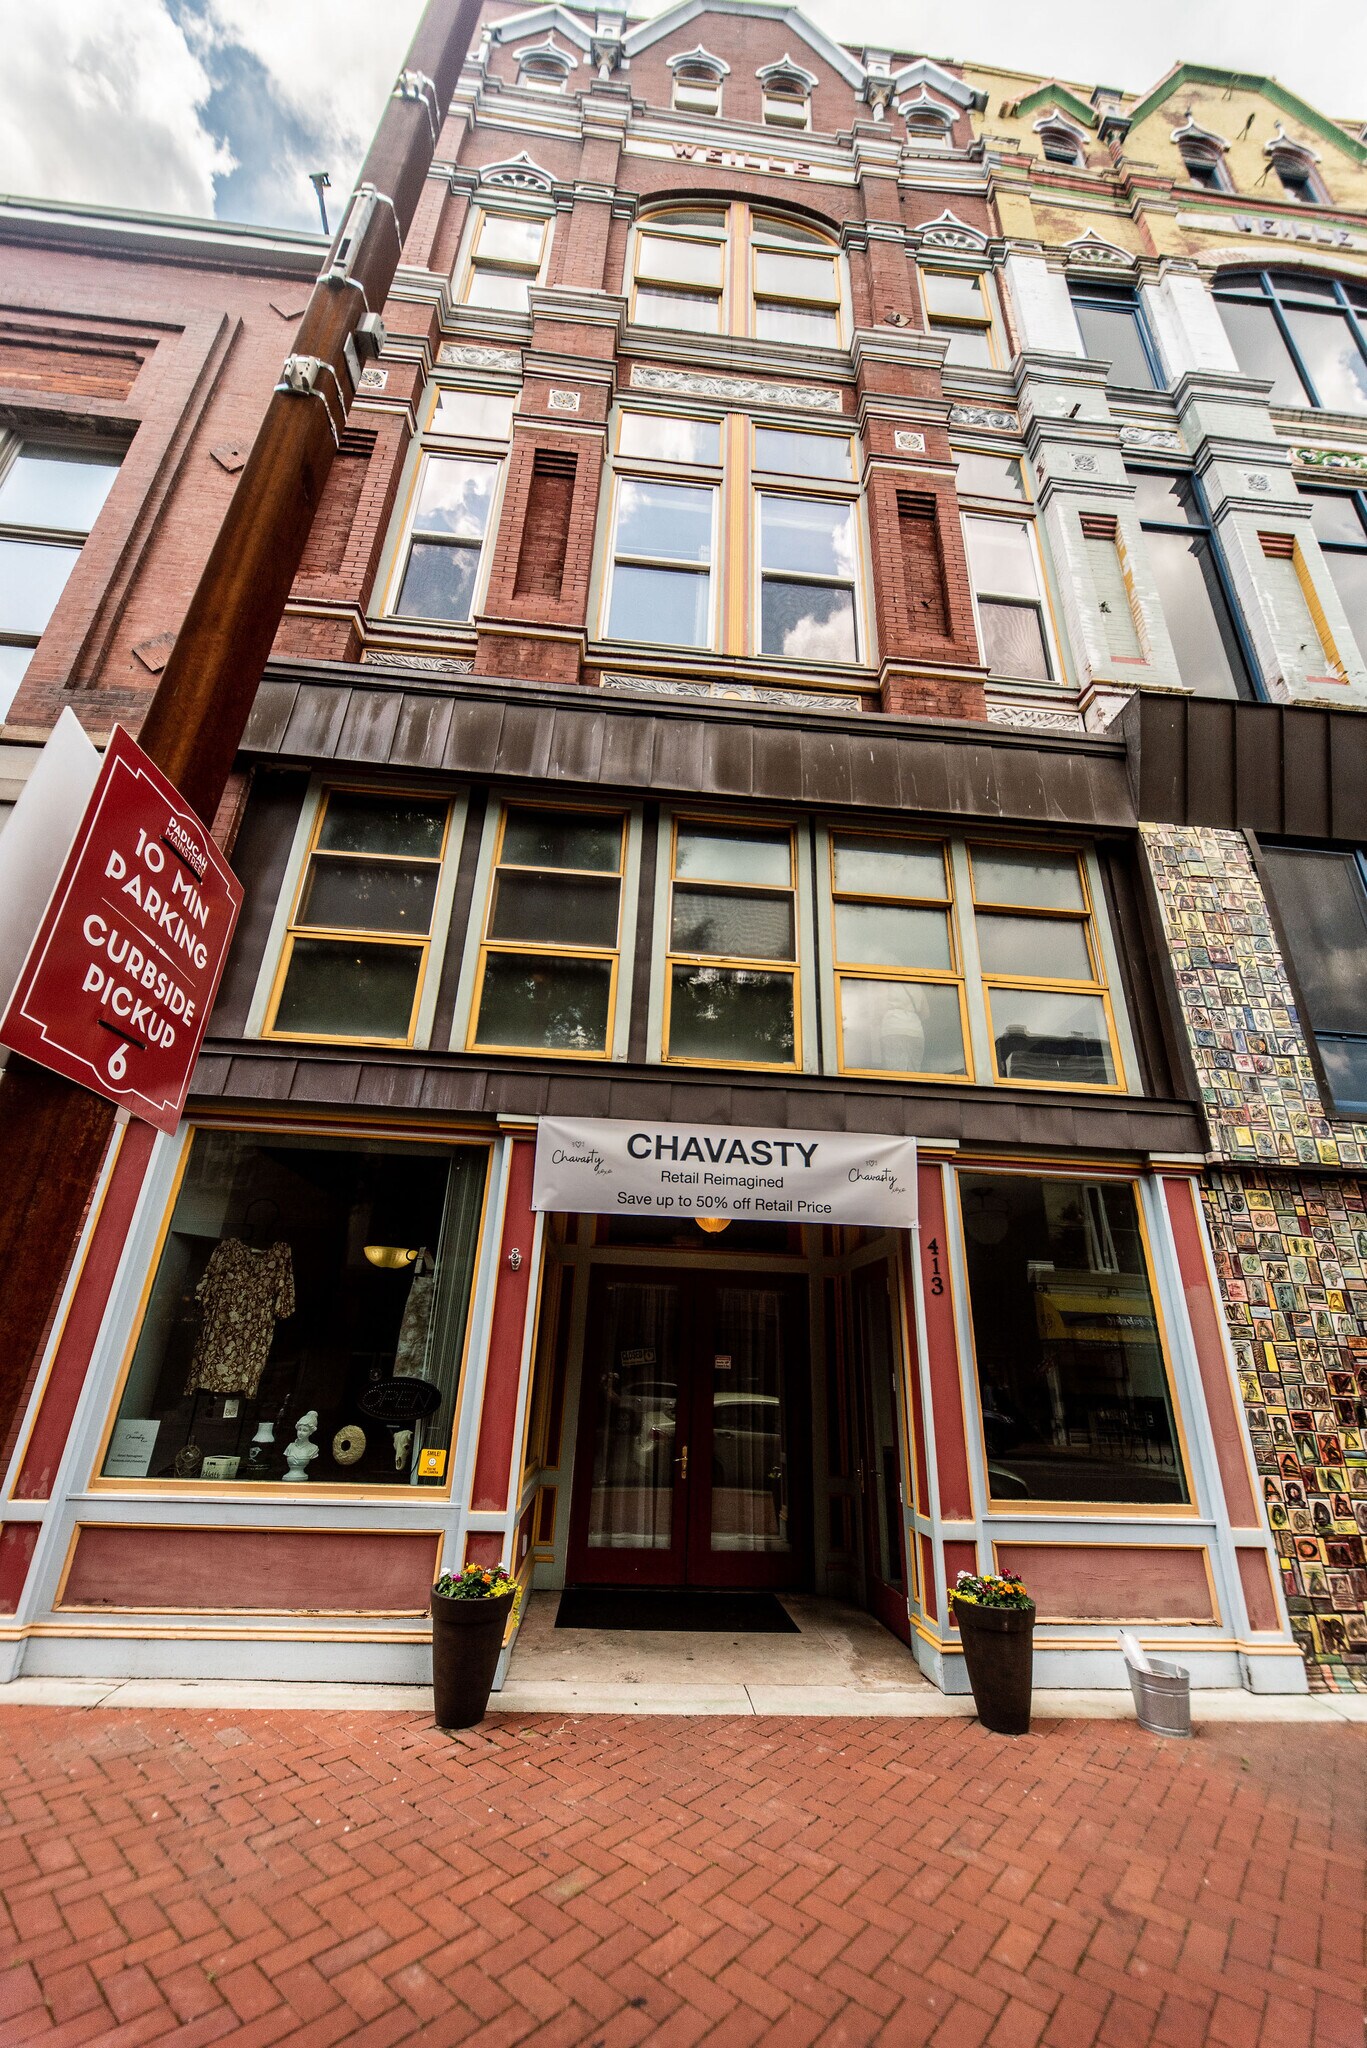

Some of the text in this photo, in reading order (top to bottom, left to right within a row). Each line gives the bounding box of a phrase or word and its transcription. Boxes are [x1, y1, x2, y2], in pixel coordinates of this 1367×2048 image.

[671, 141, 811, 176] WEILLE
[1232, 215, 1354, 248] WEILLE
[165, 827, 205, 877] MAINSTREET
[168, 816, 208, 870] PADUCAH
[135, 828, 209, 930] 10 MIN
[105, 850, 207, 970] PARKING
[83, 914, 196, 1028] CURBSIDE
[82, 963, 175, 1049] PICKUP
[107, 1043, 127, 1080] 6
[551, 1149, 605, 1171] Chavasty
[626, 1133, 819, 1168] CHAVASTY
[661, 1171, 784, 1190] Retail Reimagined
[848, 1167, 898, 1190] Chavasty
[617, 1192, 832, 1214] Save up to 50% off Retail Price
[927, 1238, 944, 1296] 413
